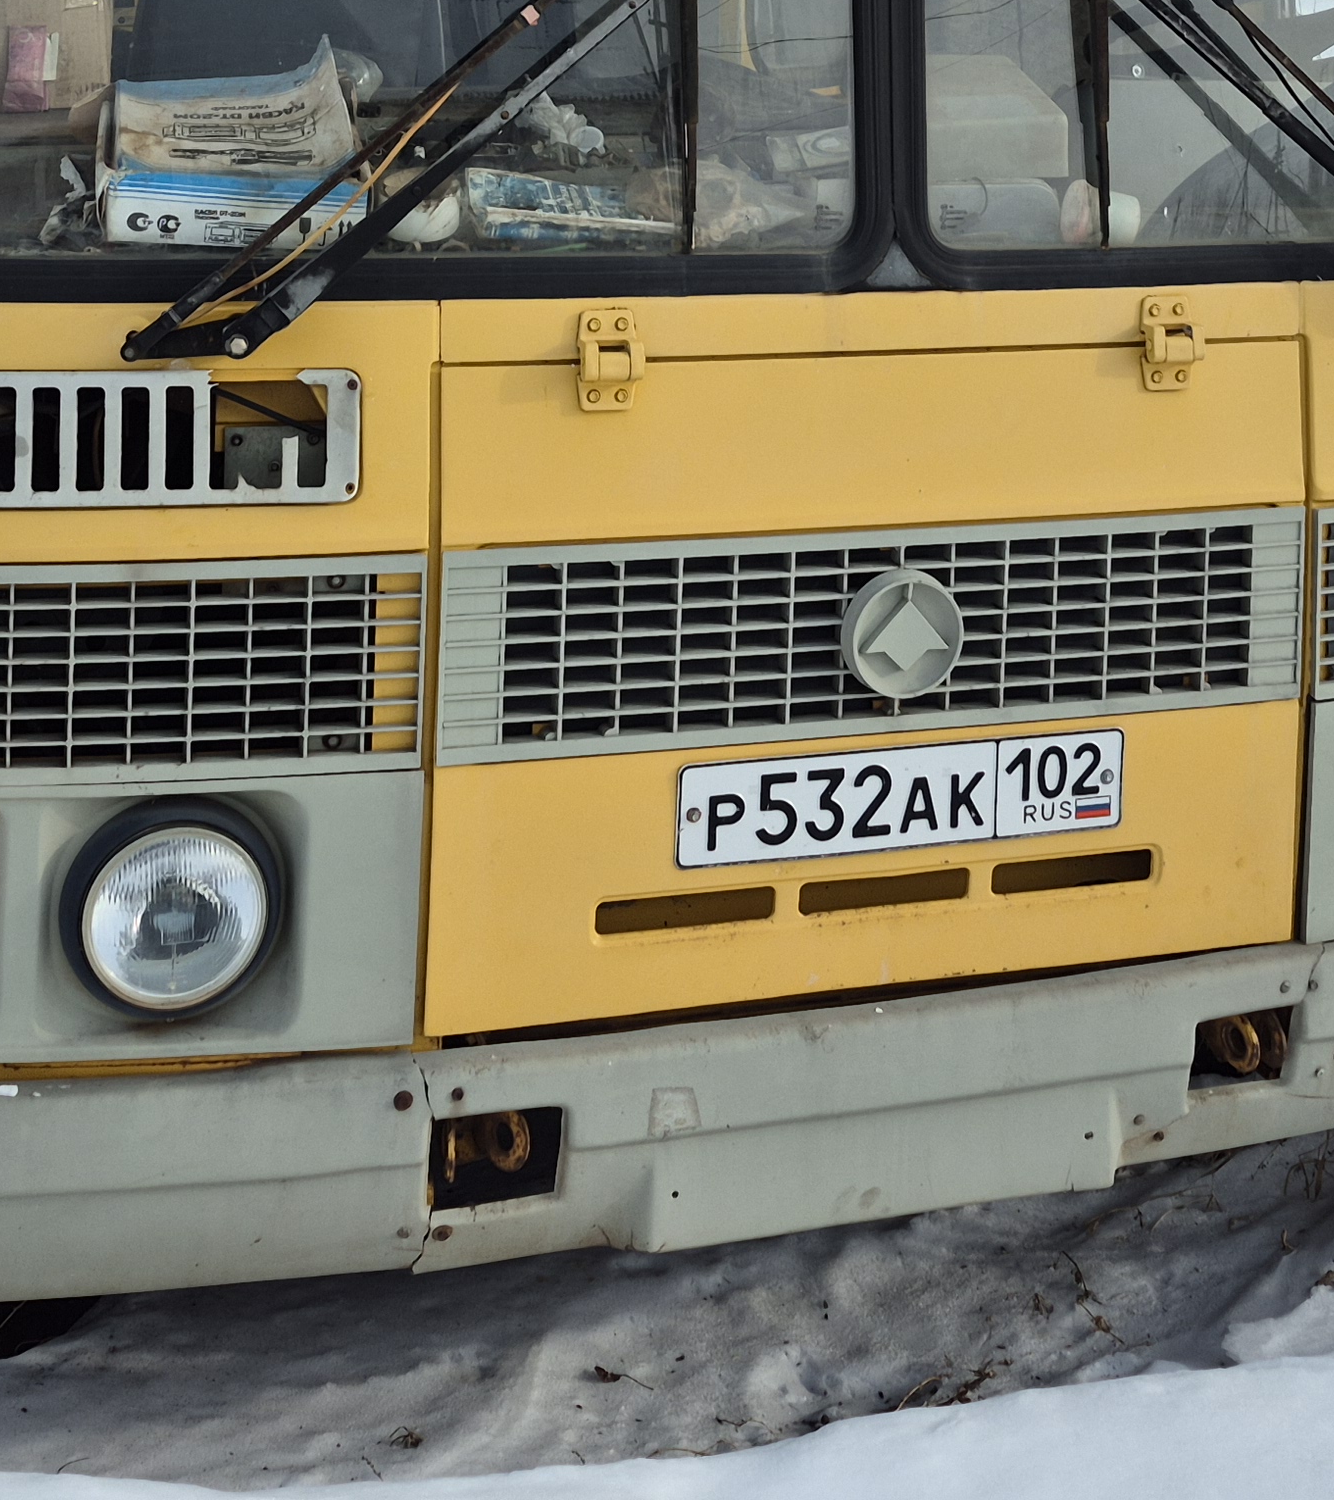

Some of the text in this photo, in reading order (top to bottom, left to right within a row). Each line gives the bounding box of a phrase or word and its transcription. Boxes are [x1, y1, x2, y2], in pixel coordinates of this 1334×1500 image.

[706, 741, 1103, 852] Р532АК 102
[1022, 800, 1073, 825] RUS
